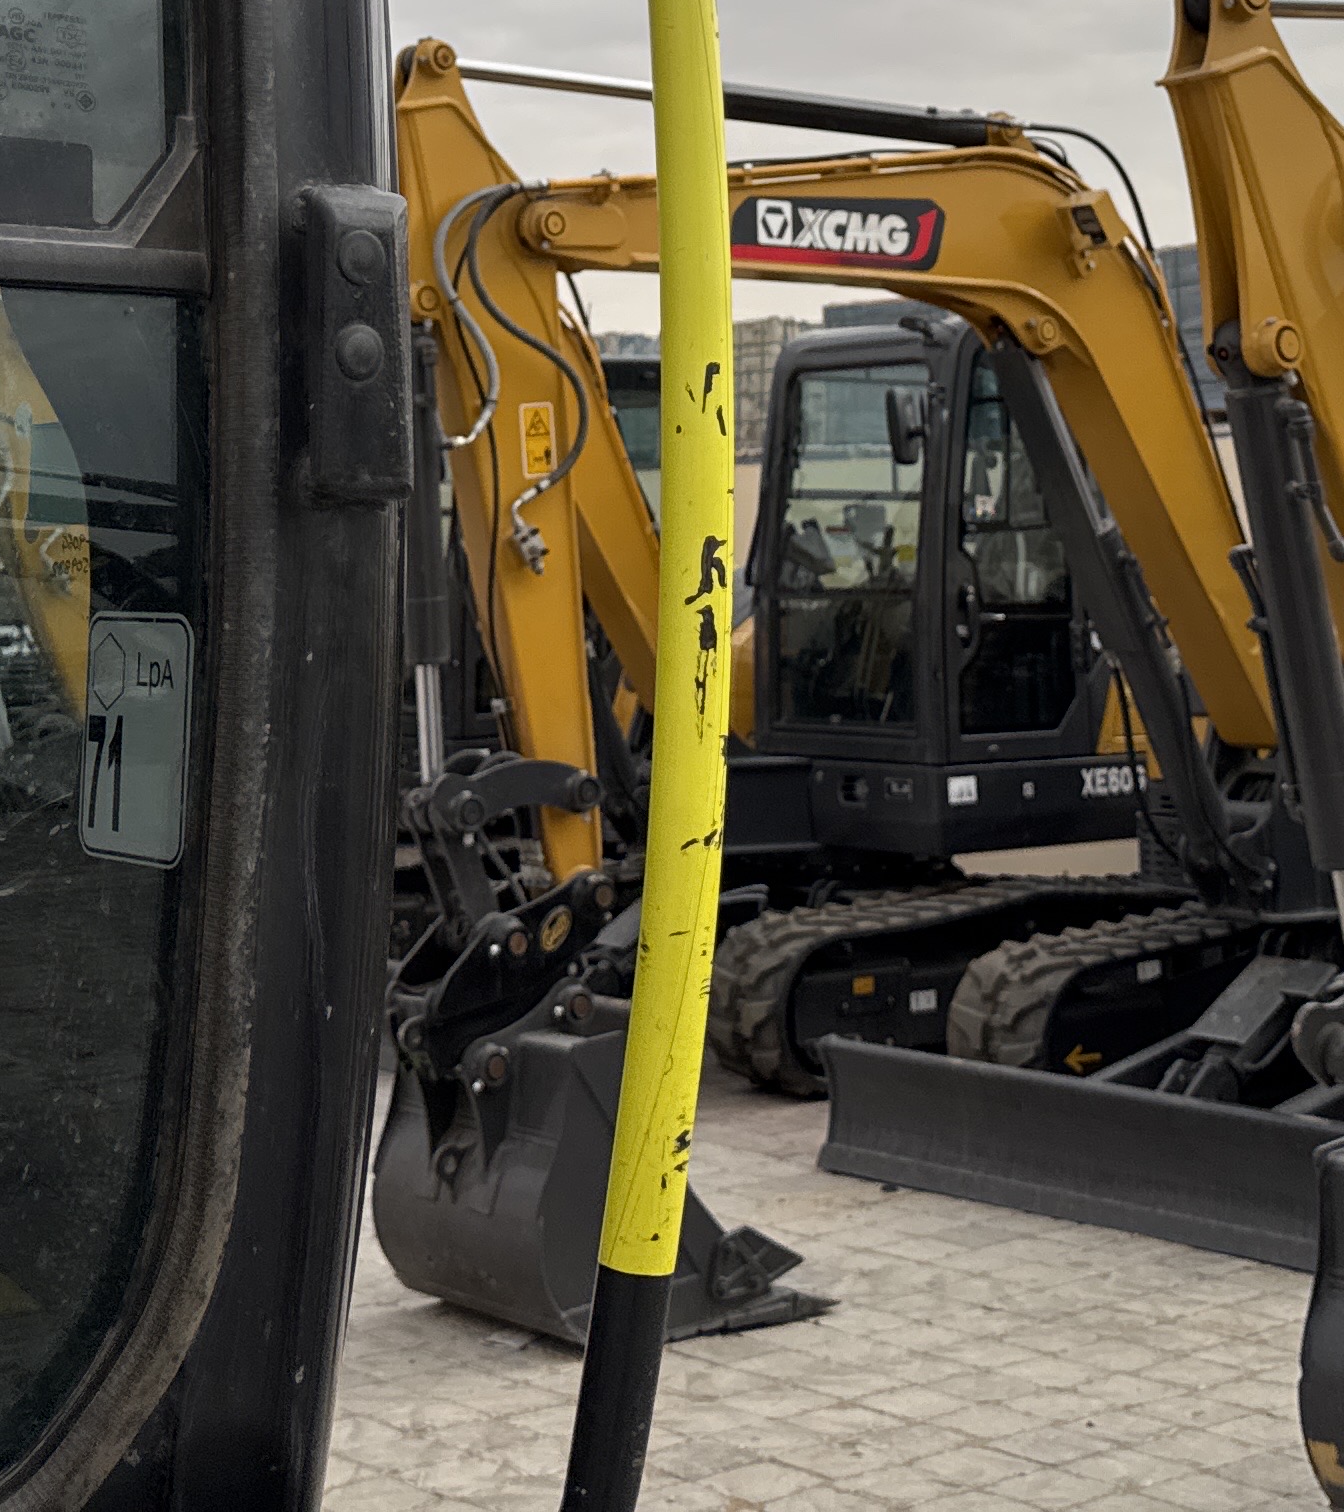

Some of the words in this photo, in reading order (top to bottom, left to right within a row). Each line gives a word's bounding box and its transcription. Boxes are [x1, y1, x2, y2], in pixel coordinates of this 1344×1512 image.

[792, 207, 910, 256] XCMG
[136, 652, 174, 696] LpA
[88, 715, 124, 832] 71
